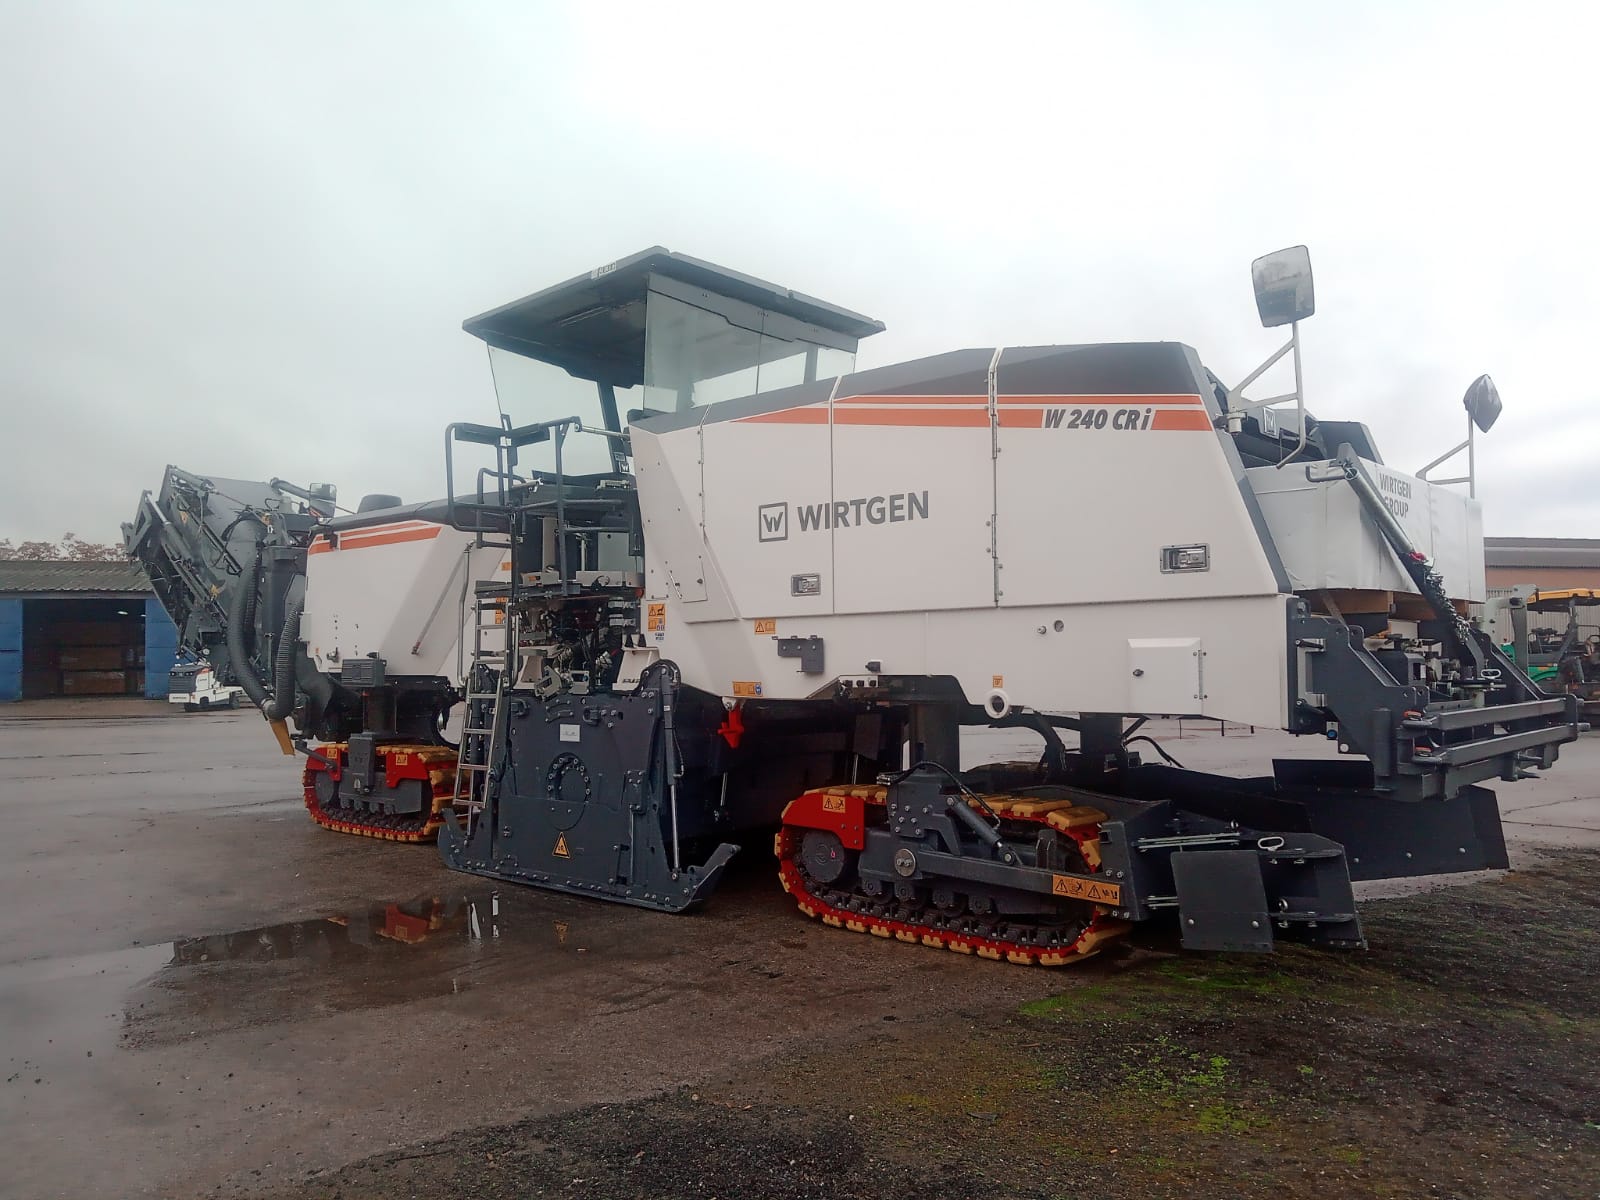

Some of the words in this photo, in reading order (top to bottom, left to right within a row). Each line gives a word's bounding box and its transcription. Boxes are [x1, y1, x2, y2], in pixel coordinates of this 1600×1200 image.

[1045, 409, 1066, 428] W
[1067, 409, 1108, 429] 240
[1113, 408, 1151, 430] CRi
[1380, 473, 1411, 499] WIRTGEN
[797, 491, 928, 531] WIRTGEN
